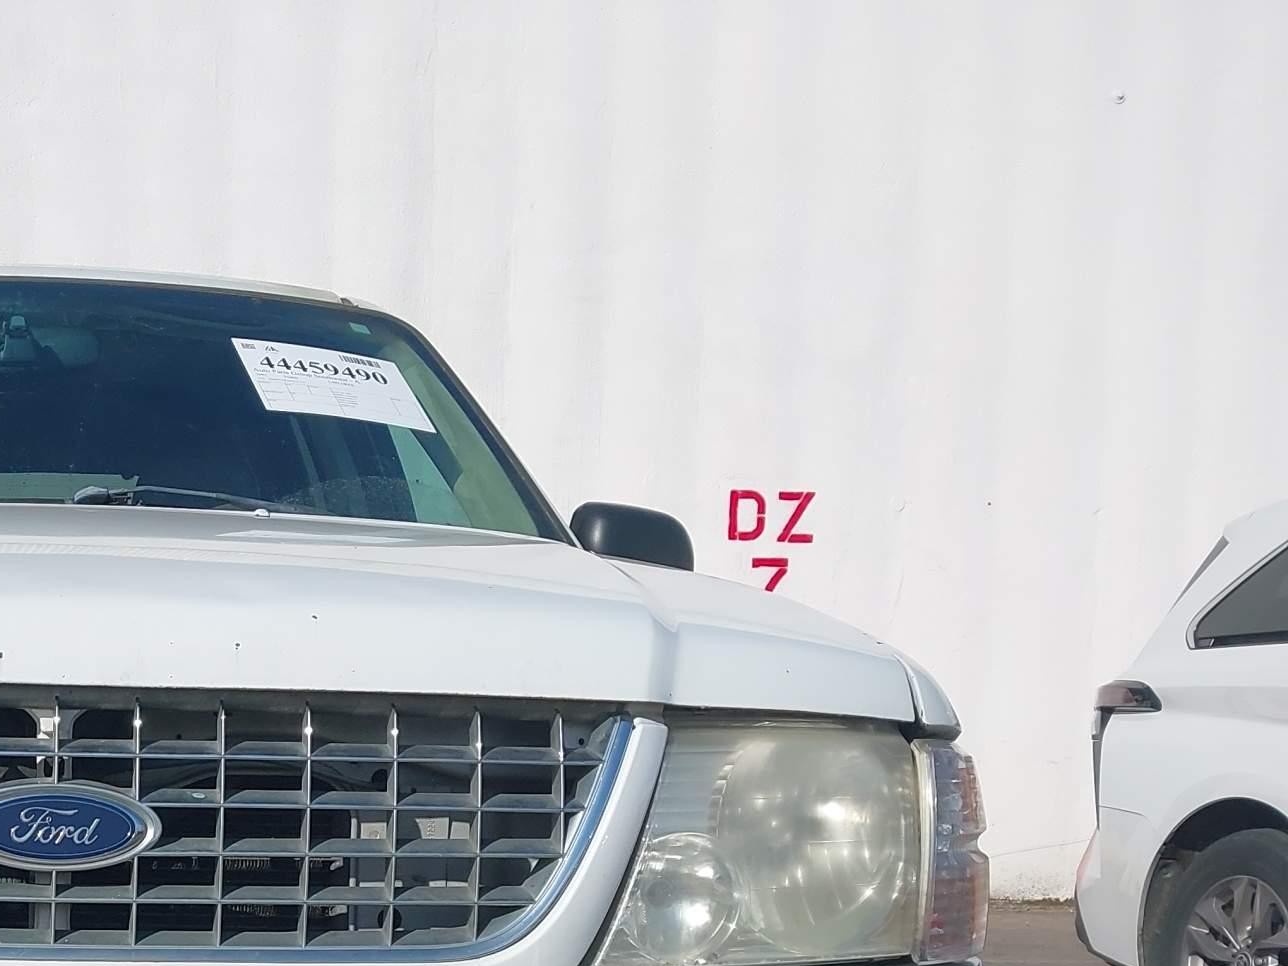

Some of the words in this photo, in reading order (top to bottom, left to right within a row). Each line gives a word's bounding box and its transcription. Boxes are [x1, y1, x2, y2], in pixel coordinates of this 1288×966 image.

[260, 356, 388, 385] 44459490
[728, 490, 816, 543] DZ
[752, 558, 788, 592] 7
[10, 806, 100, 845] Ford
